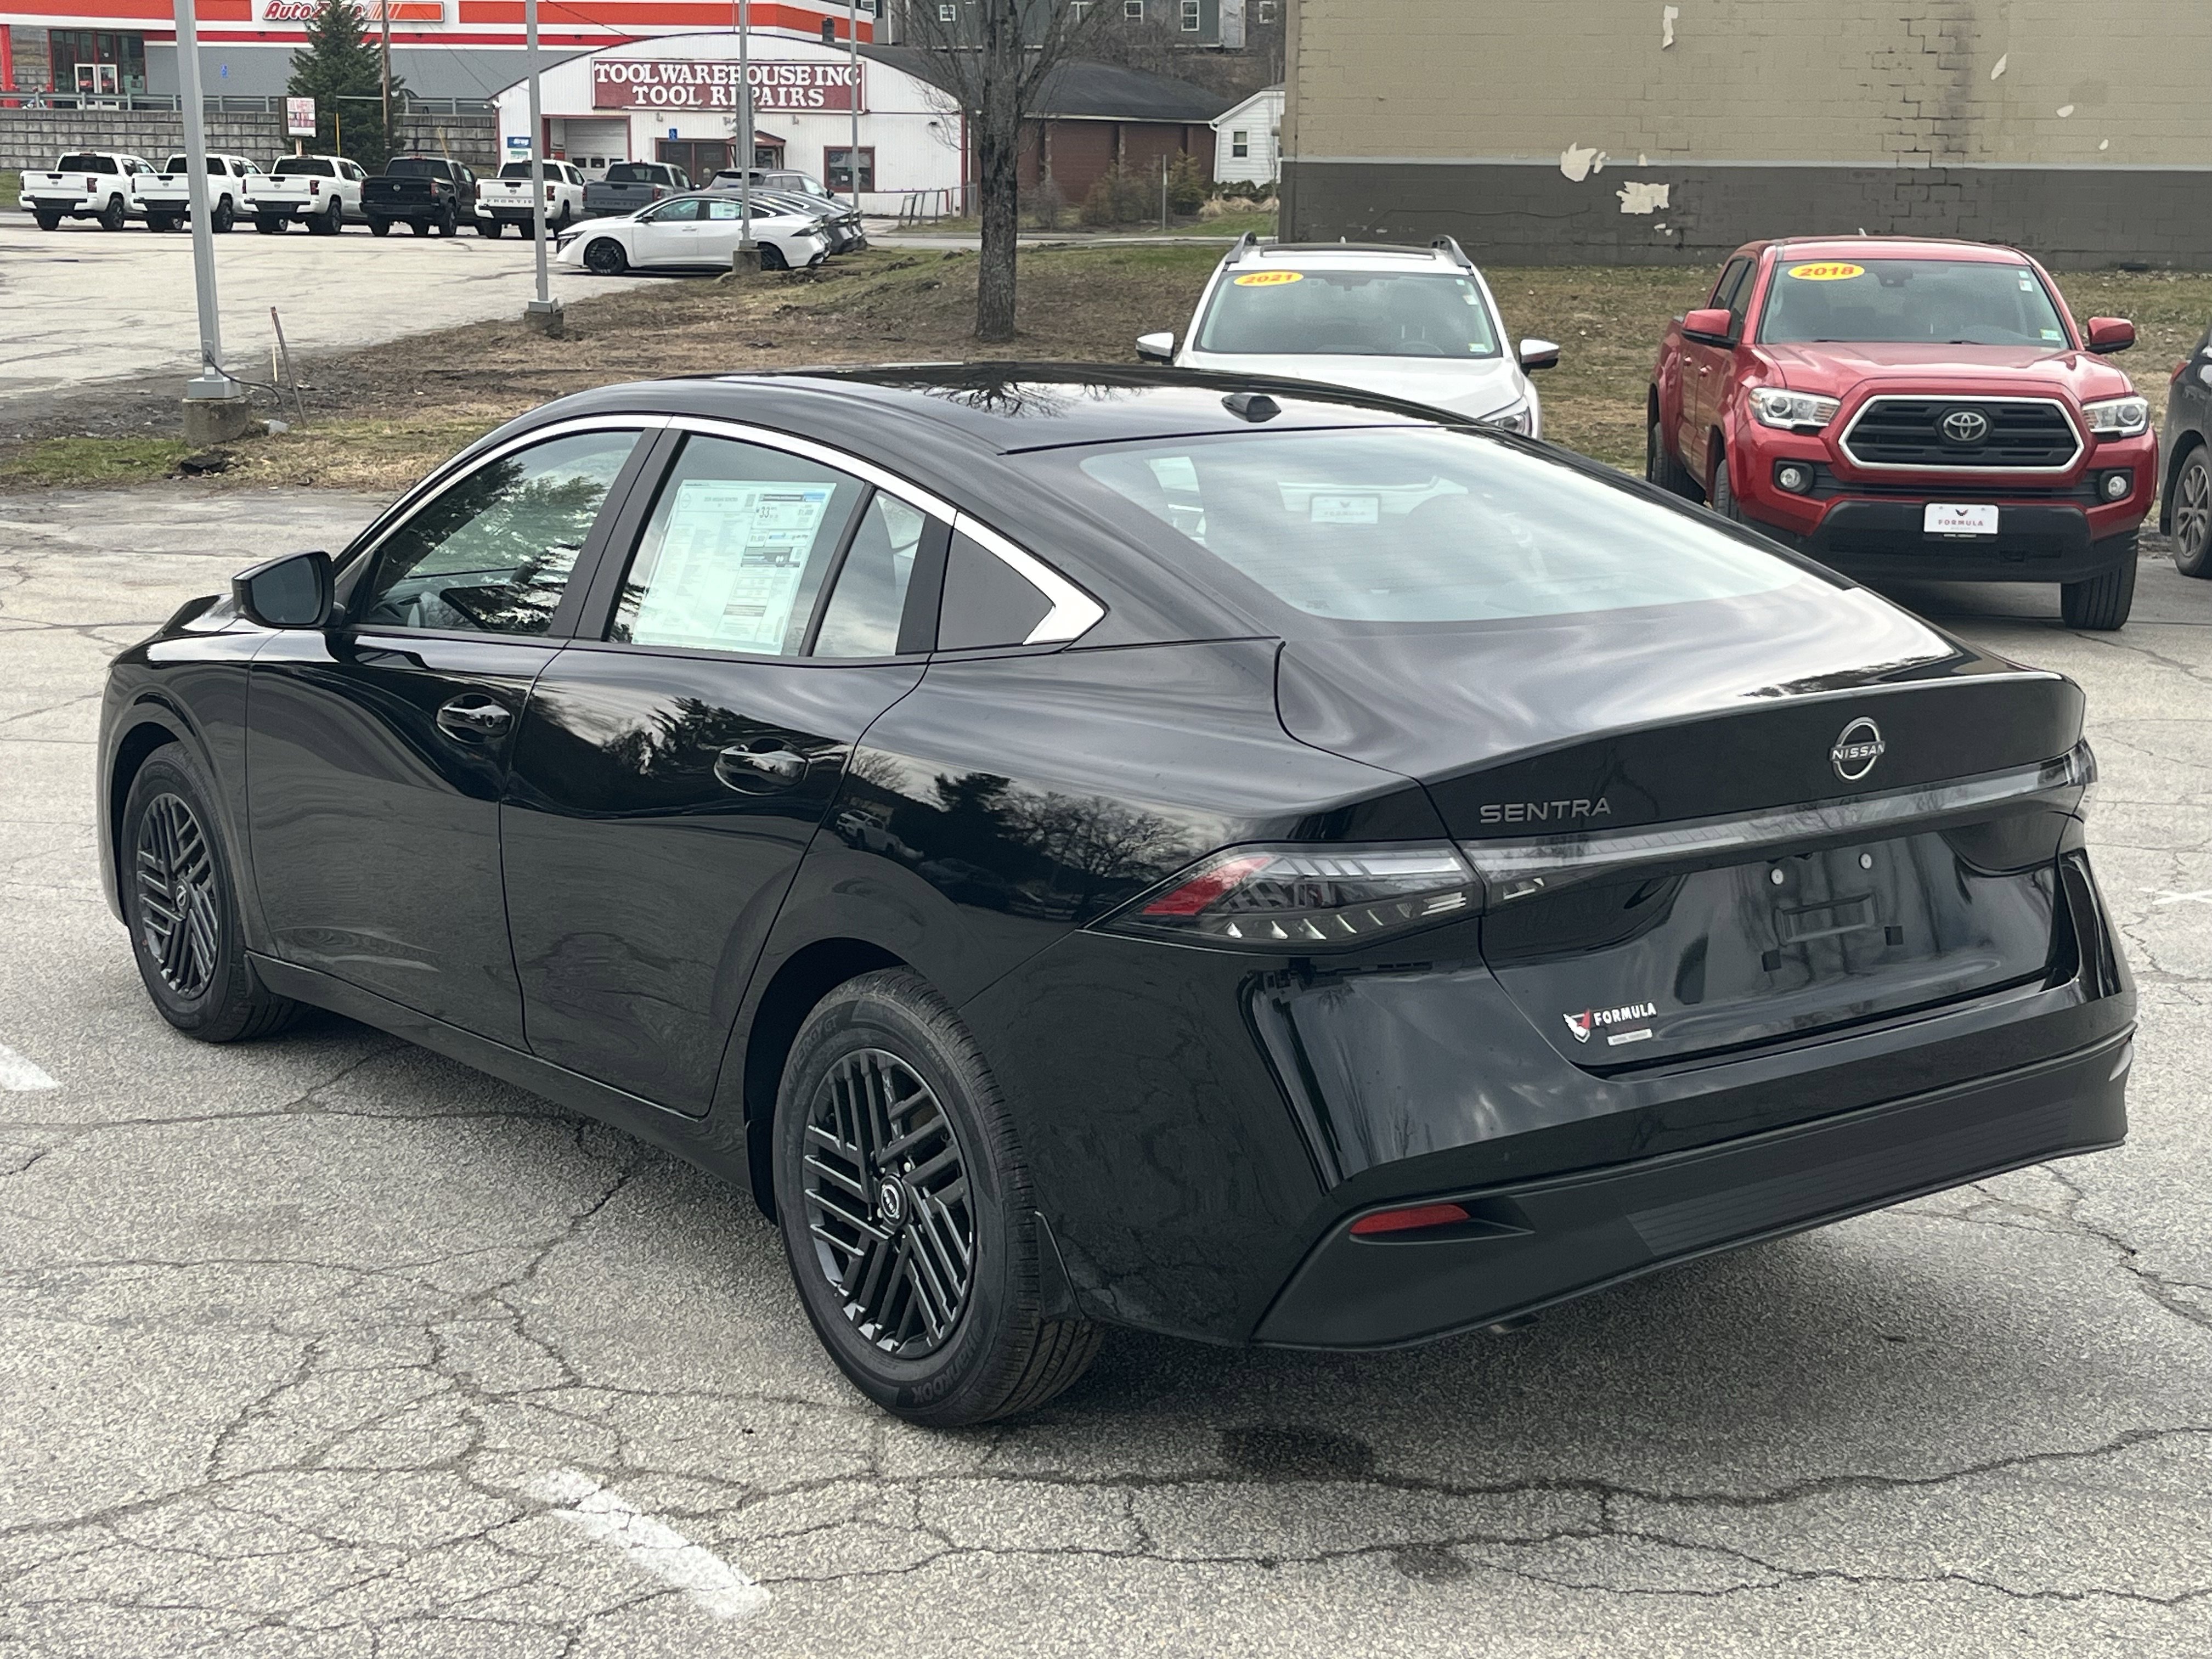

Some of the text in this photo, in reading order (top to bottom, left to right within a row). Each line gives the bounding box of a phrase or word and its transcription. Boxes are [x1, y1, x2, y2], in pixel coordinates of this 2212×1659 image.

[594, 63, 658, 83] TOOL
[814, 66, 861, 86] INC
[632, 85, 703, 106] TOOL
[1243, 274, 1294, 284] 2021
[1798, 267, 1854, 277] 2018
[1832, 744, 1884, 760] NISSAN
[1480, 797, 1611, 824] SENTRA
[1593, 1002, 1657, 1026] FORMULA
